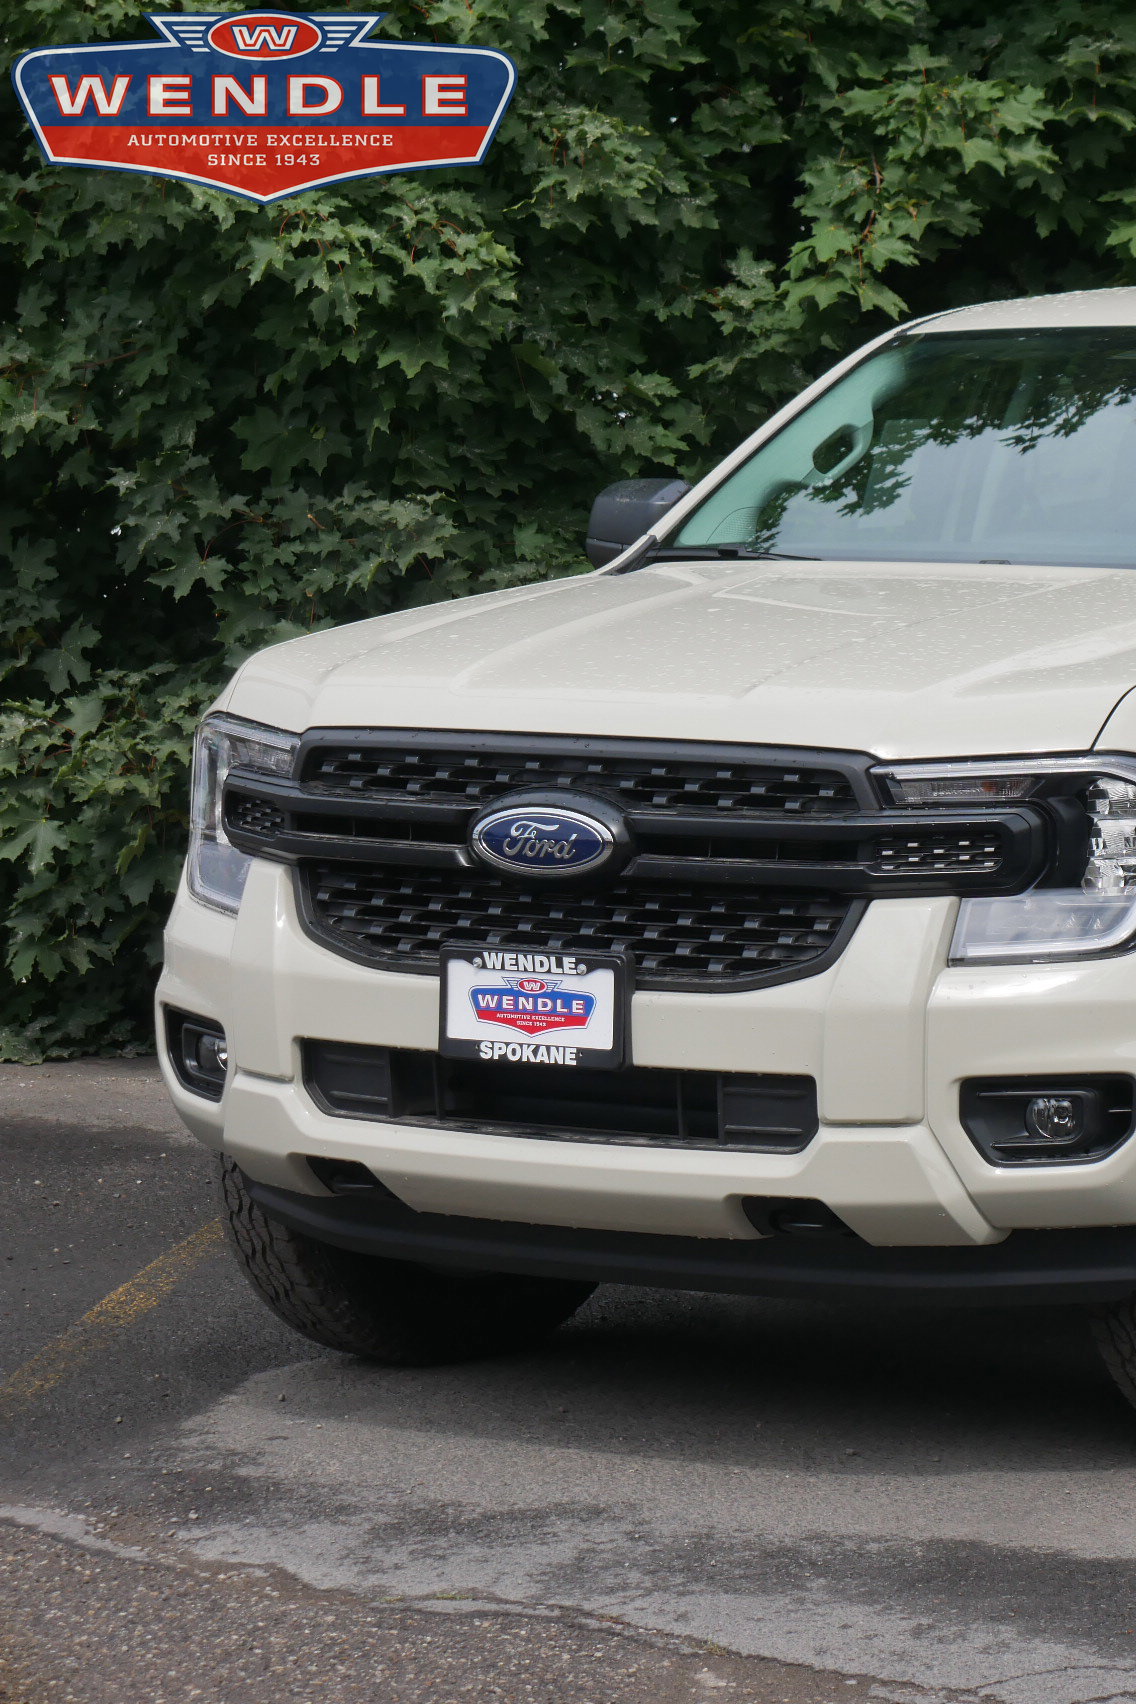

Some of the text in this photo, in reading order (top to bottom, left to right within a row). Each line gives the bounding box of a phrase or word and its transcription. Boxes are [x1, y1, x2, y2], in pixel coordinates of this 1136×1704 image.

[503, 820, 578, 860] Ford
[483, 951, 577, 975] WENDLE
[478, 994, 585, 1014] WENDLE
[479, 1041, 577, 1066] SPOKANE
